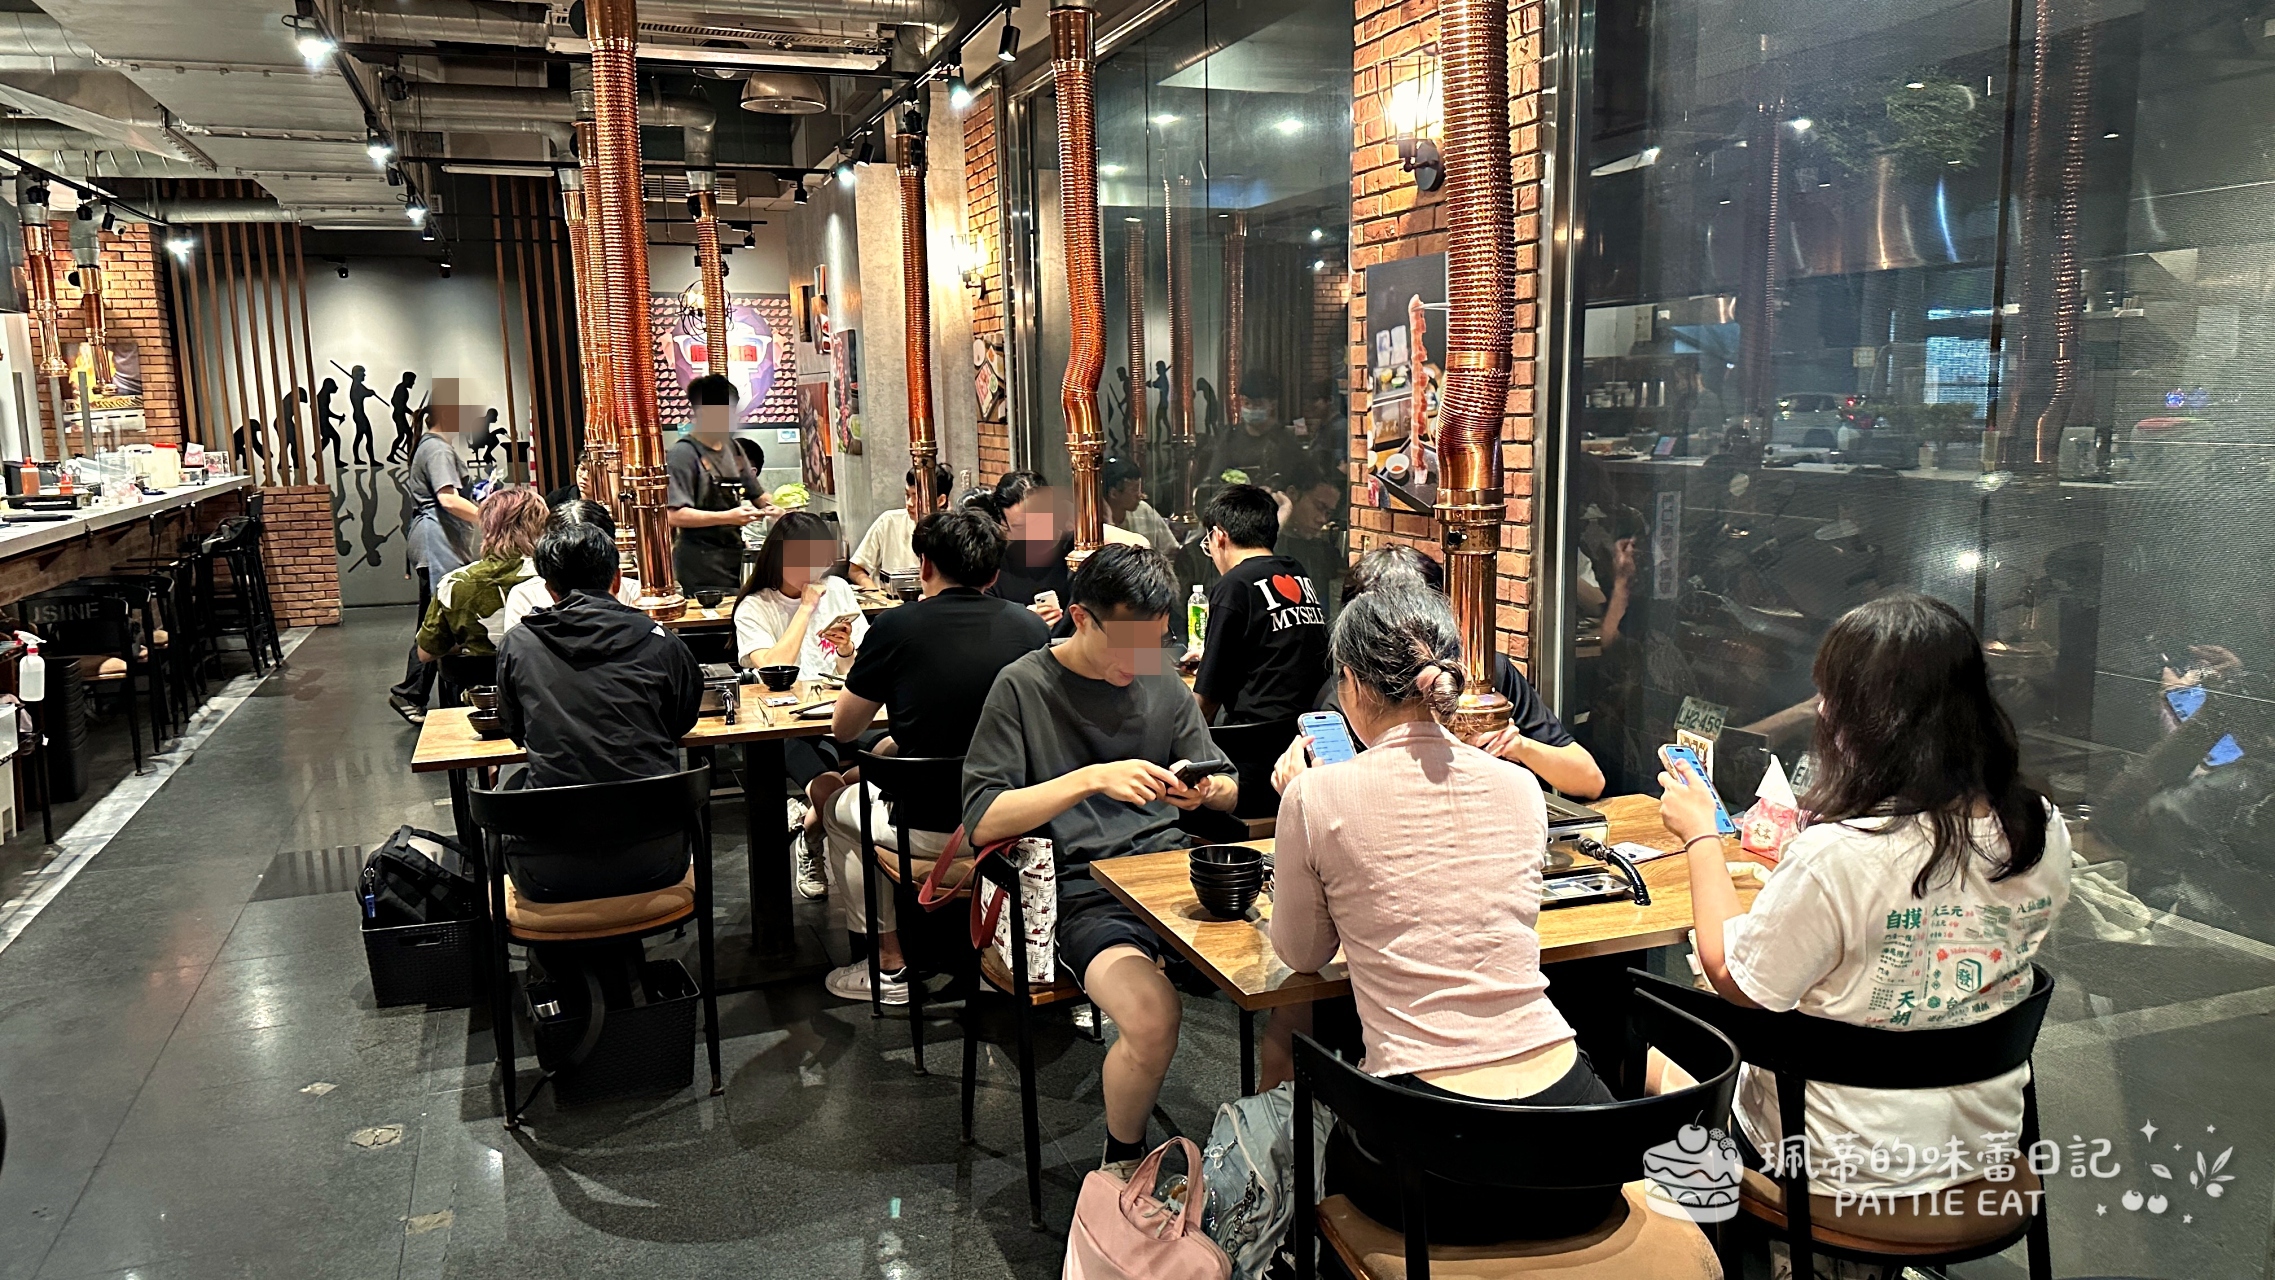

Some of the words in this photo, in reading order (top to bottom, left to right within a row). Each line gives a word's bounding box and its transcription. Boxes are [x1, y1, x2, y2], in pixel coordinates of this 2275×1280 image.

[1253, 578, 1281, 611] I
[1293, 575, 1320, 605] M
[1886, 907, 1922, 930] 自摸
[1931, 904, 1963, 917] 大三元
[1889, 990, 1916, 1027] 天胡
